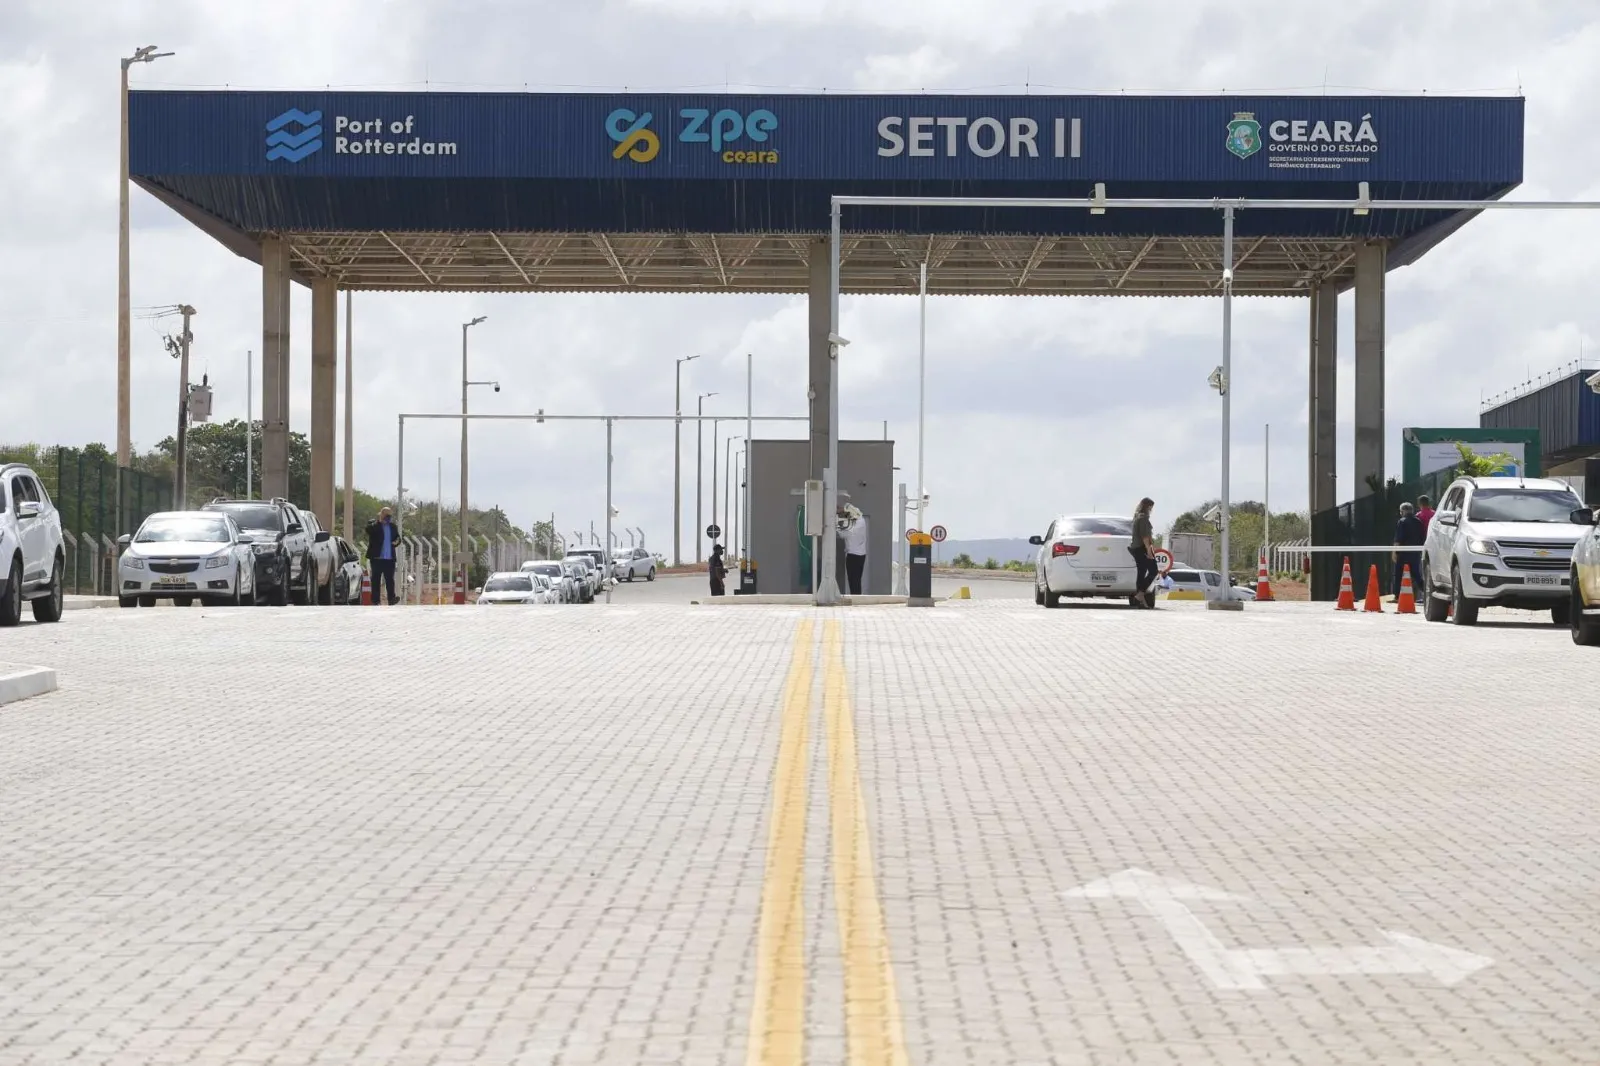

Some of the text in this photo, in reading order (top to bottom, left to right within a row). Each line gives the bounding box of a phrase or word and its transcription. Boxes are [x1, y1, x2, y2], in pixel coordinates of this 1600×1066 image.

[335, 115, 414, 134] Port of
[679, 108, 778, 153] zpe
[1269, 113, 1378, 143] CEARÁ
[335, 137, 457, 155] Rotterdam
[877, 116, 1081, 158] SETOR II
[722, 148, 779, 164] ceará
[1269, 144, 1378, 153] GOVERNO DO ESTADO
[1155, 555, 1168, 563] 30
